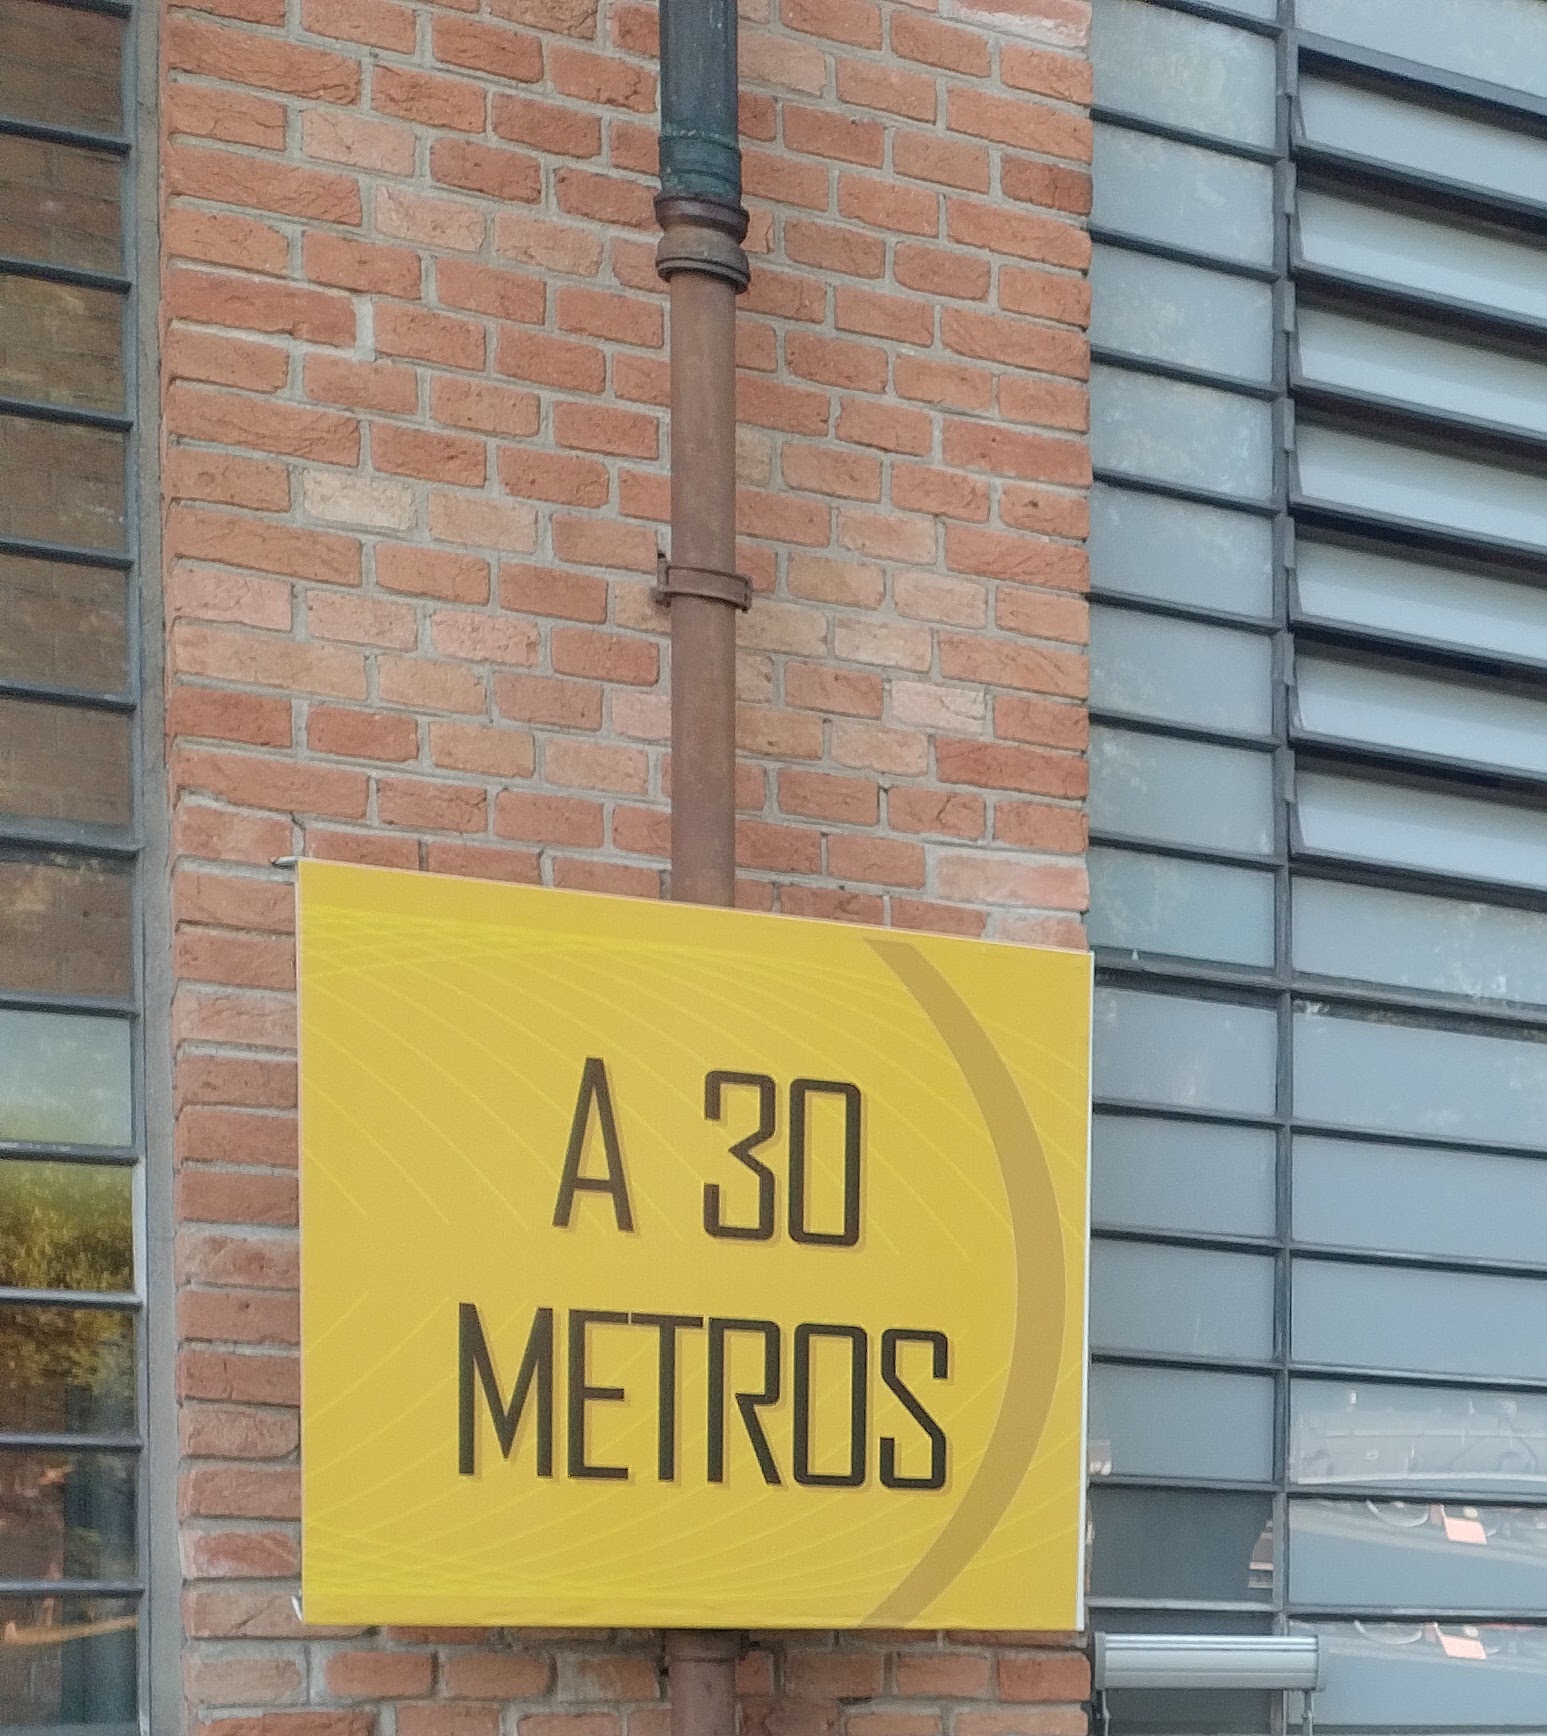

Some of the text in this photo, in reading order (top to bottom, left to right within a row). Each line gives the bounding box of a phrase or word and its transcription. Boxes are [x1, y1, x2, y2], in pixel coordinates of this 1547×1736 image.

[555, 1058, 862, 1247] A 30
[458, 1303, 949, 1491] METROS
